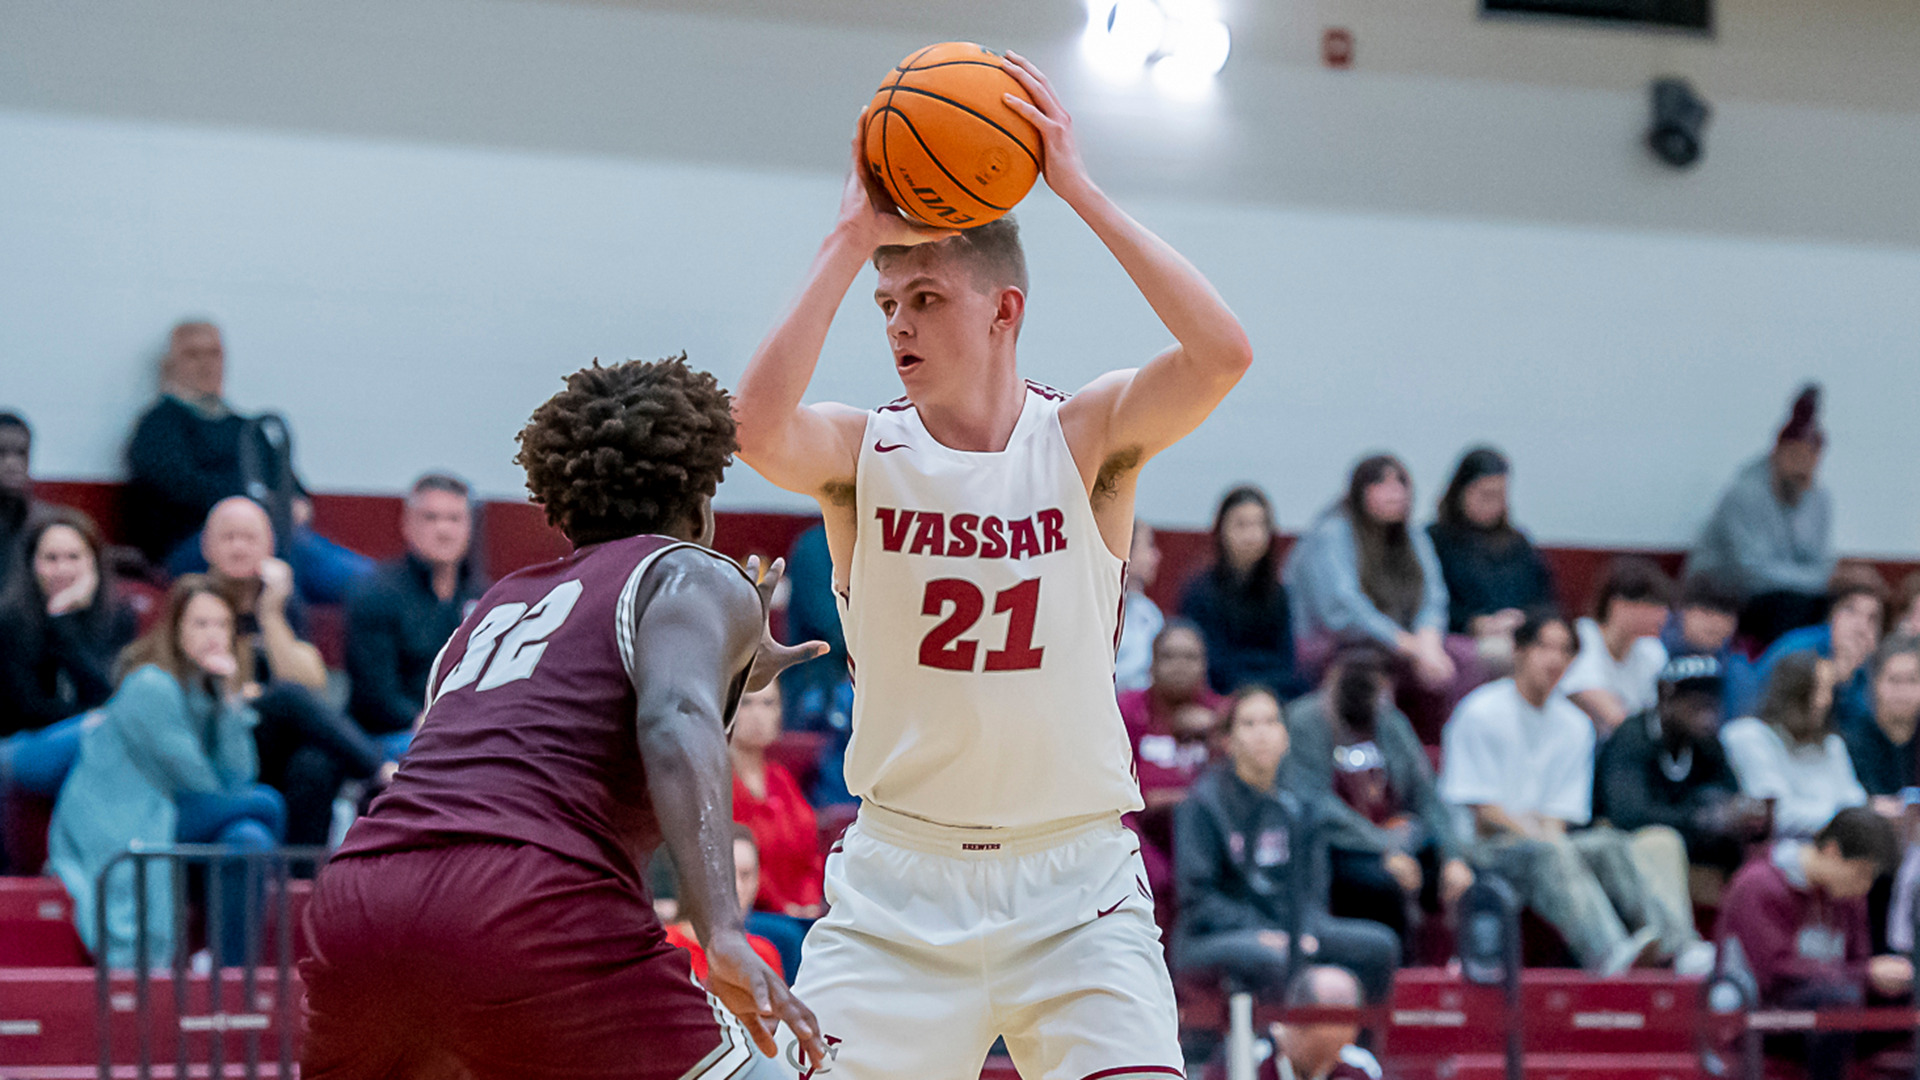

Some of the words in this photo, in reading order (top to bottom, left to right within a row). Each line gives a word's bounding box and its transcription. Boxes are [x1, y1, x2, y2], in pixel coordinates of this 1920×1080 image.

[874, 507, 1067, 560] VASSAR
[918, 576, 1045, 673] 21
[962, 843, 1001, 851] BREWERS
